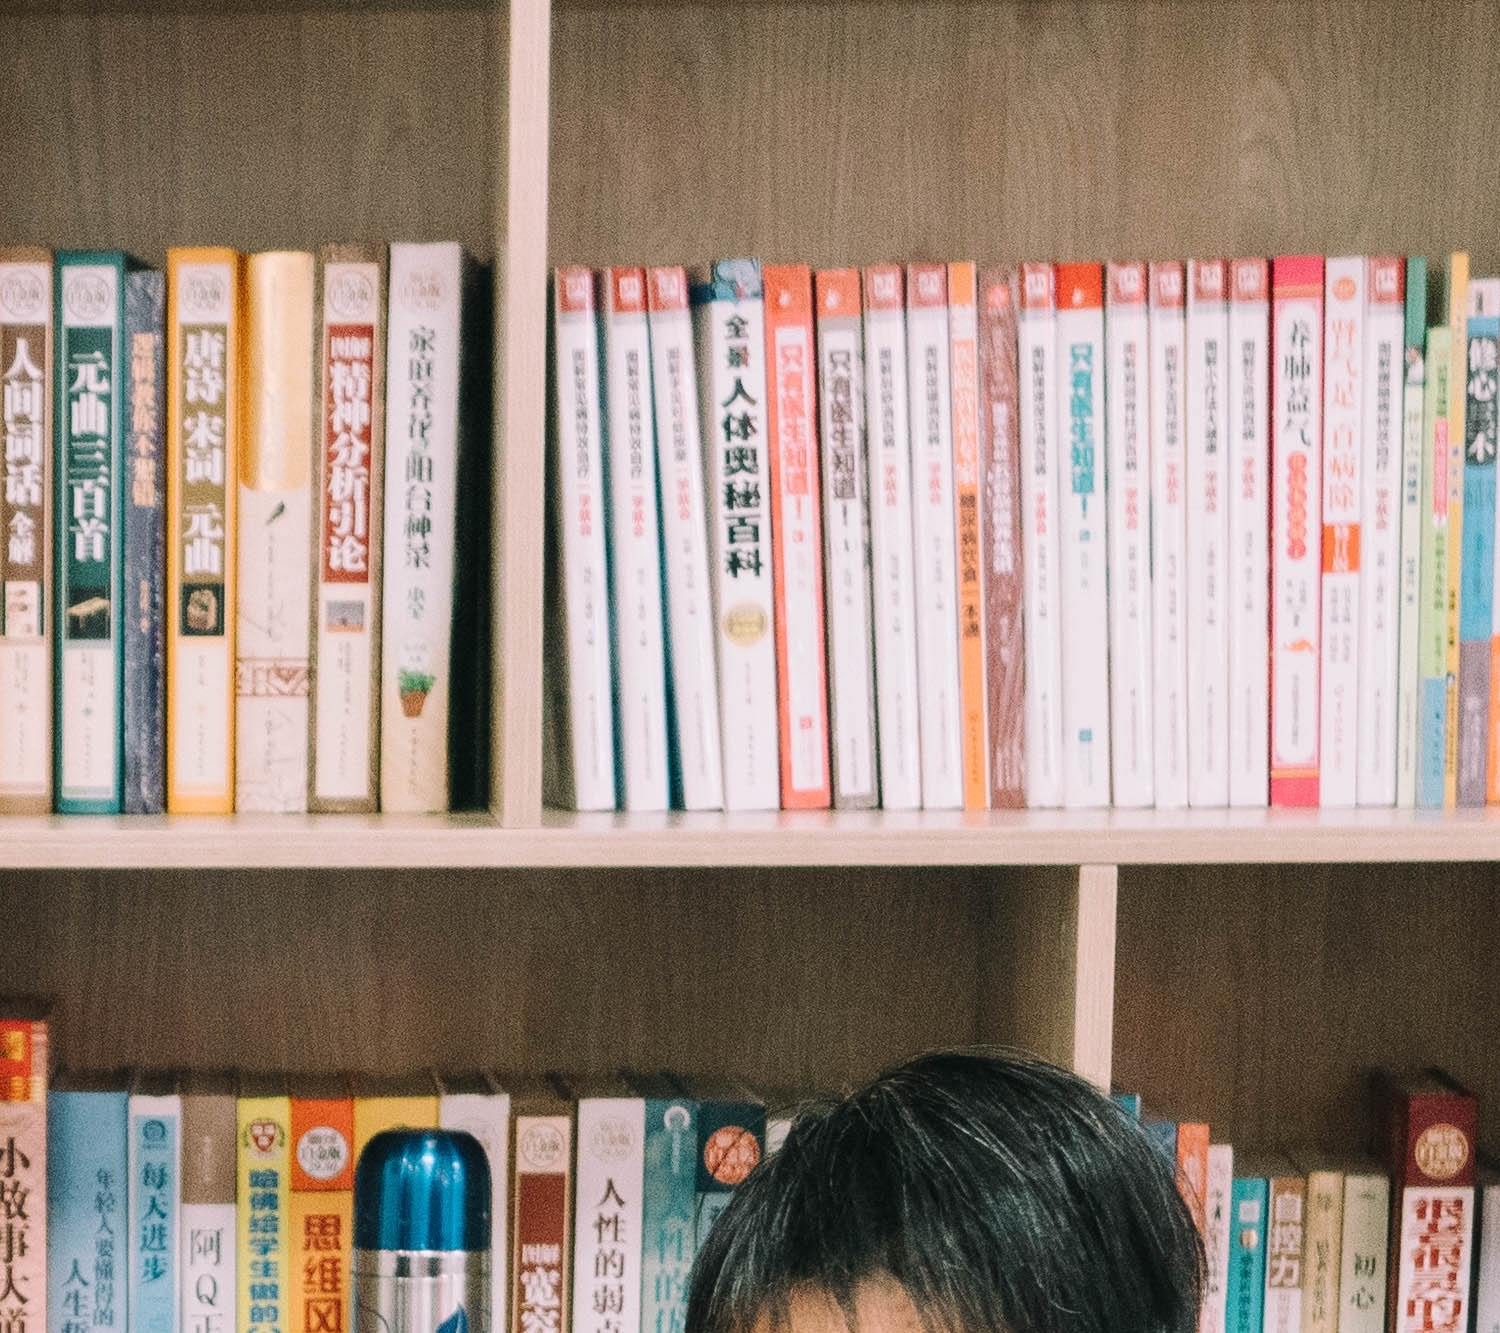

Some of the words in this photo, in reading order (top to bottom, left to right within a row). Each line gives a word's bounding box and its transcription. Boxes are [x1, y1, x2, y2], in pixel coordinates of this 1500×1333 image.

[3, 336, 42, 504] 人间词话
[183, 332, 224, 403] 唐诗
[69, 350, 110, 563] 元曲三百首
[183, 416, 224, 485] 宋词
[328, 362, 369, 573] 精神分析引论
[183, 503, 222, 576] 元曲
[94, 1169, 114, 1327] 年轻人要懂得的
[1270, 1194, 1301, 1289] 自控力
